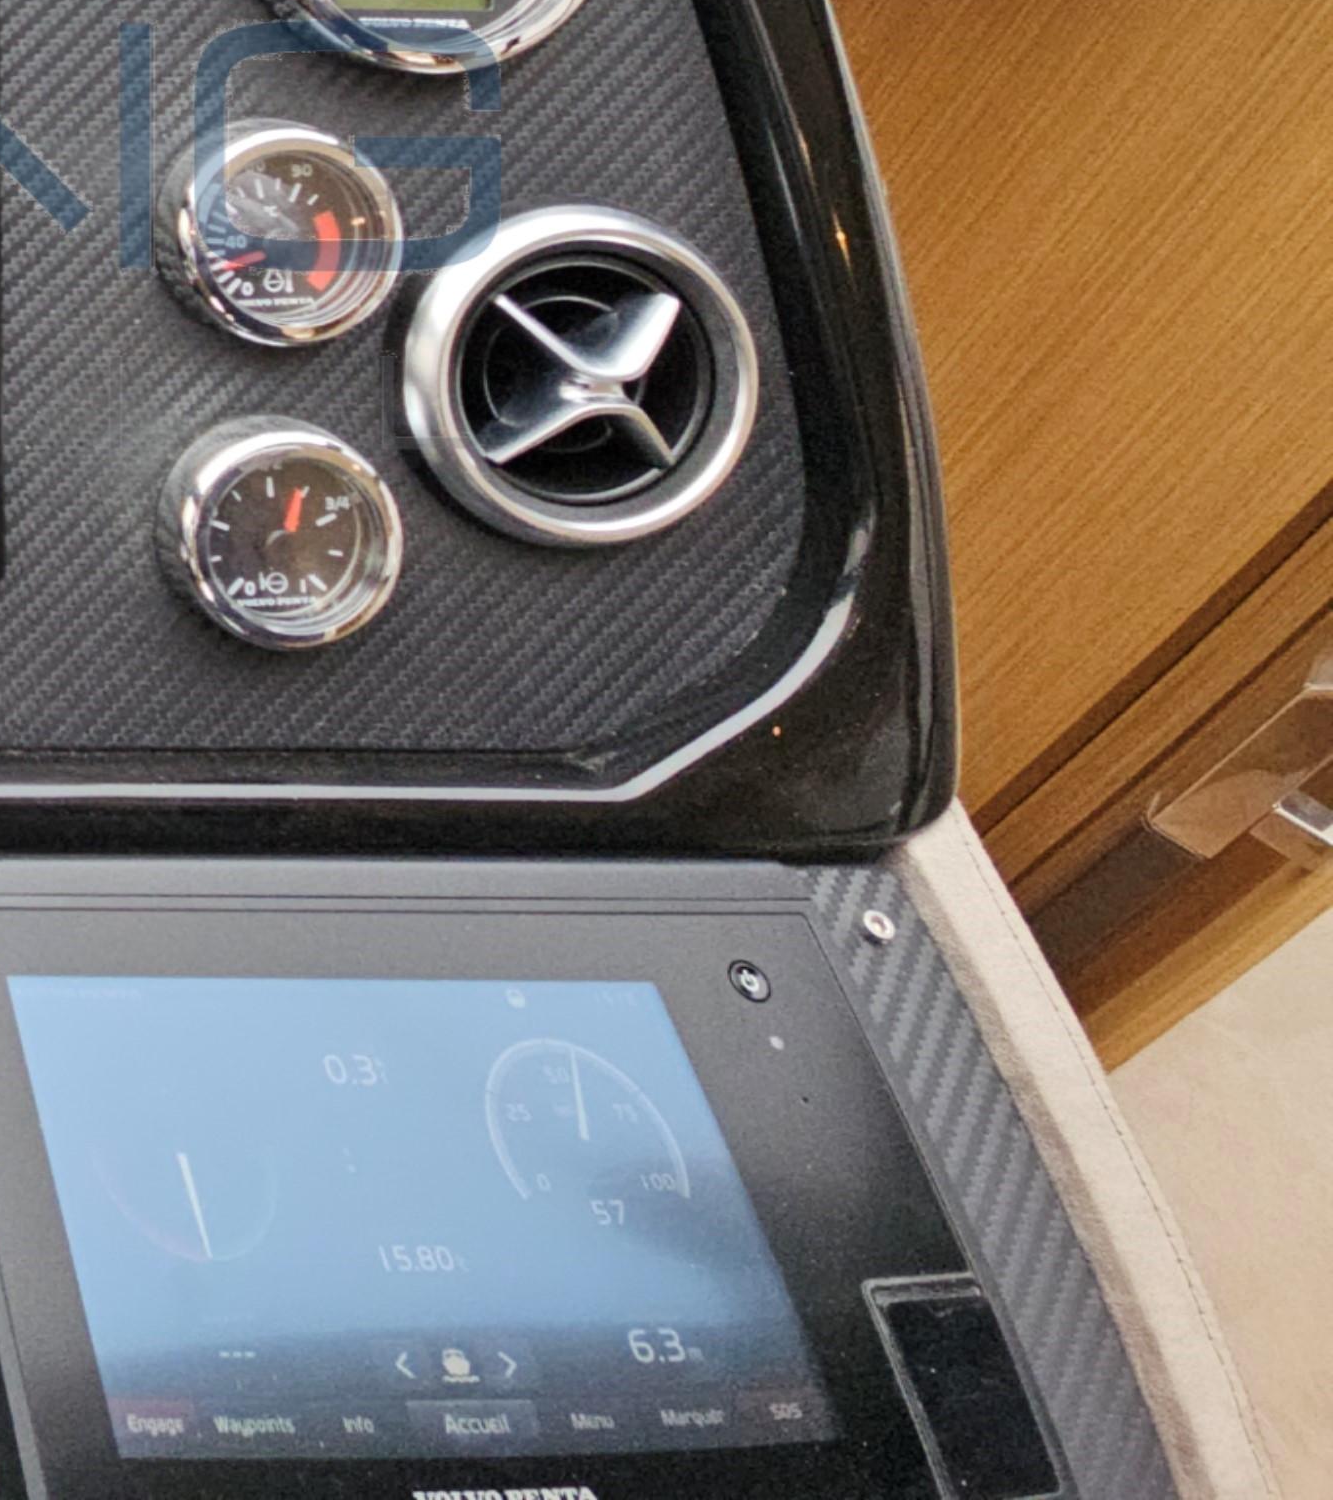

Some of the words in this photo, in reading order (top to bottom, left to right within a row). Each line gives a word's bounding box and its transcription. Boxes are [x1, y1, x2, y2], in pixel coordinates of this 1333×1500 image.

[240, 281, 255, 297] 0
[244, 581, 256, 597] 0
[589, 1199, 626, 1225] 57
[213, 1414, 297, 1438] Waypoints
[342, 1414, 375, 1434] Info
[444, 1413, 512, 1435] Accueil
[570, 1412, 616, 1431] Menu
[769, 1402, 803, 1421] SOS
